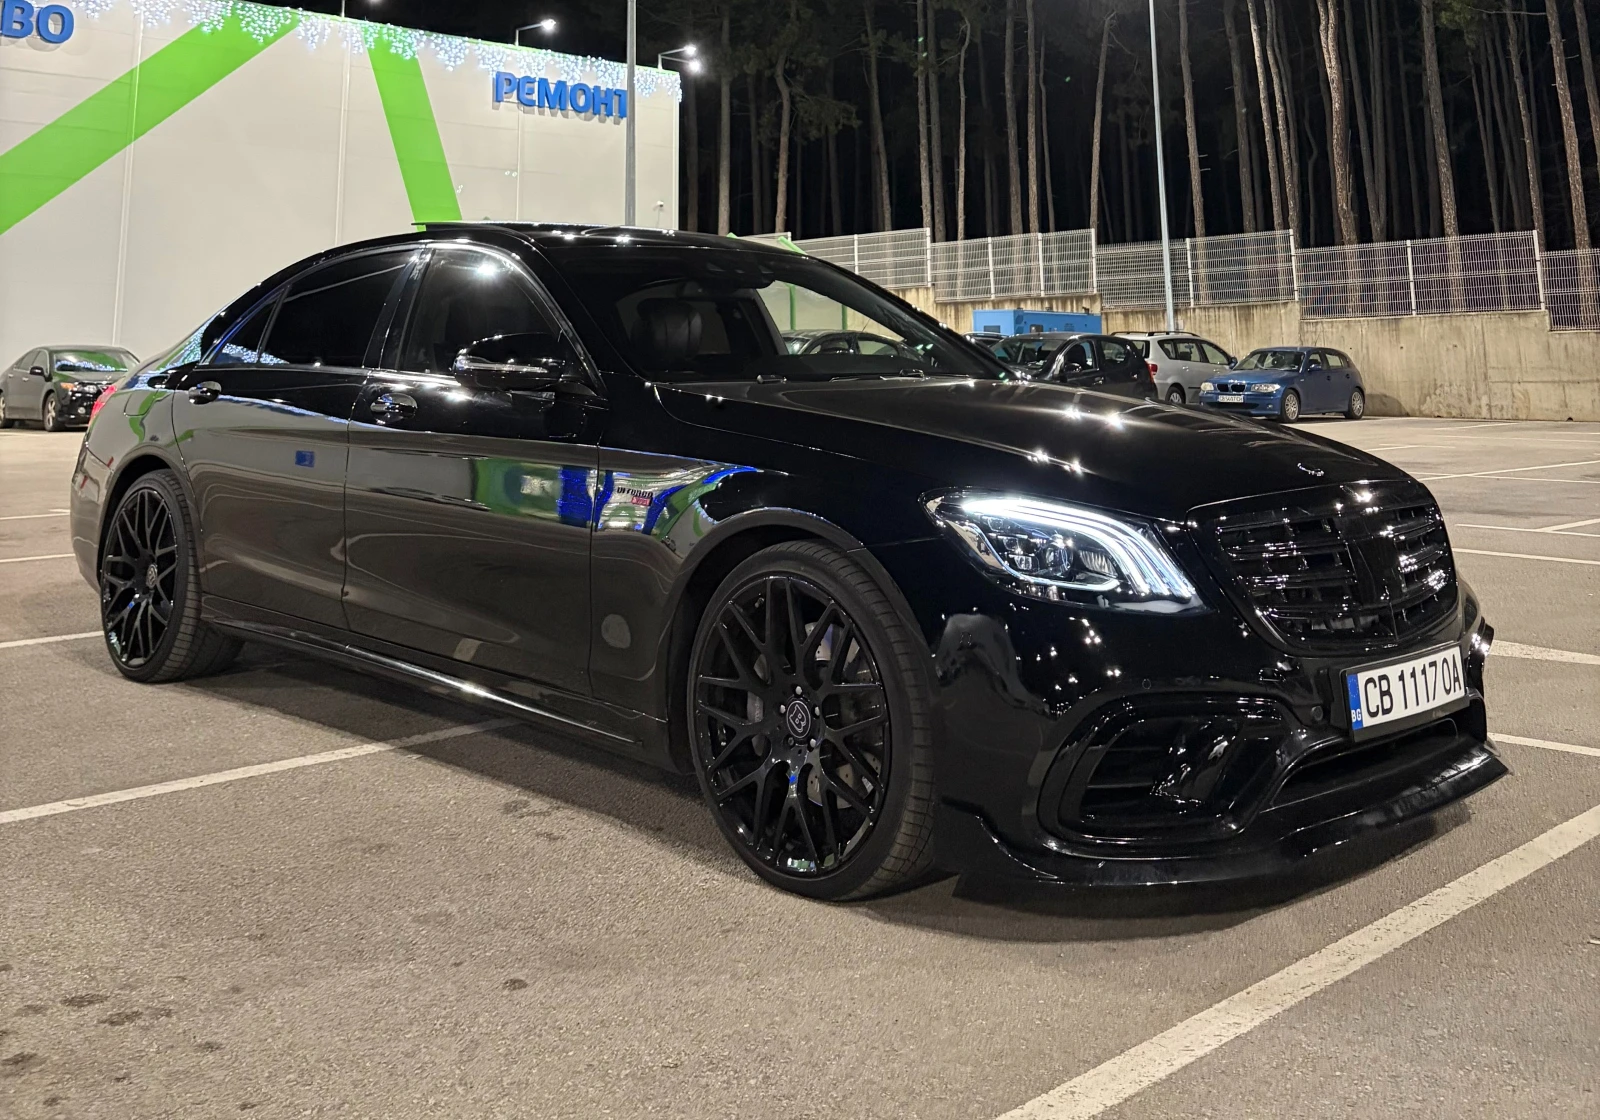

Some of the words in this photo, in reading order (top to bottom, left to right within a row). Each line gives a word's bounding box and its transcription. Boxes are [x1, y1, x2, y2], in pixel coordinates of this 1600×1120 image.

[1, 0, 75, 44] ВО
[495, 71, 628, 119] РЕМОНТ
[1364, 674, 1394, 718] CB
[1398, 660, 1438, 710] 1117
[1351, 708, 1362, 723] BG
